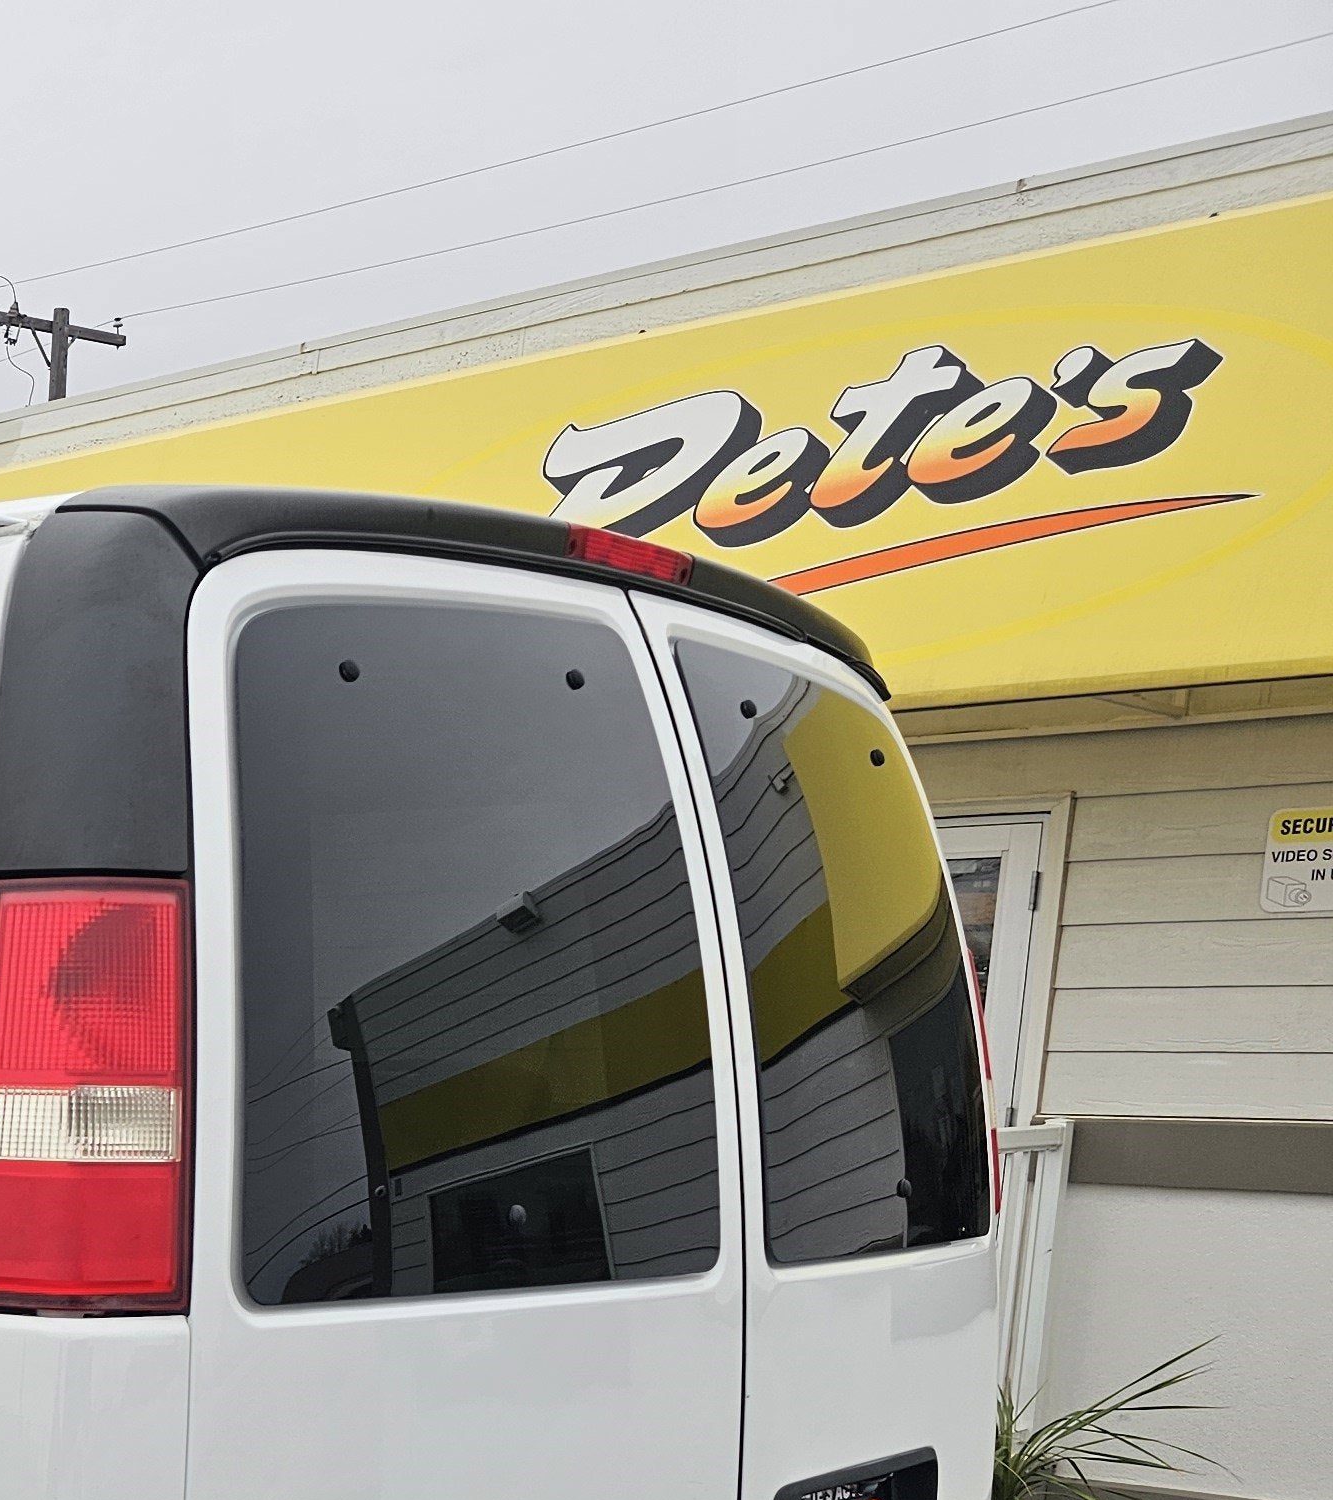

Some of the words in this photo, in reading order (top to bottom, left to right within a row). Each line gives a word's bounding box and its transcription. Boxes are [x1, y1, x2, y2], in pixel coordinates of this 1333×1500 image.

[543, 338, 1224, 548] Pete's
[1272, 849, 1318, 862] VIDEO
[1311, 868, 1325, 880] IN
